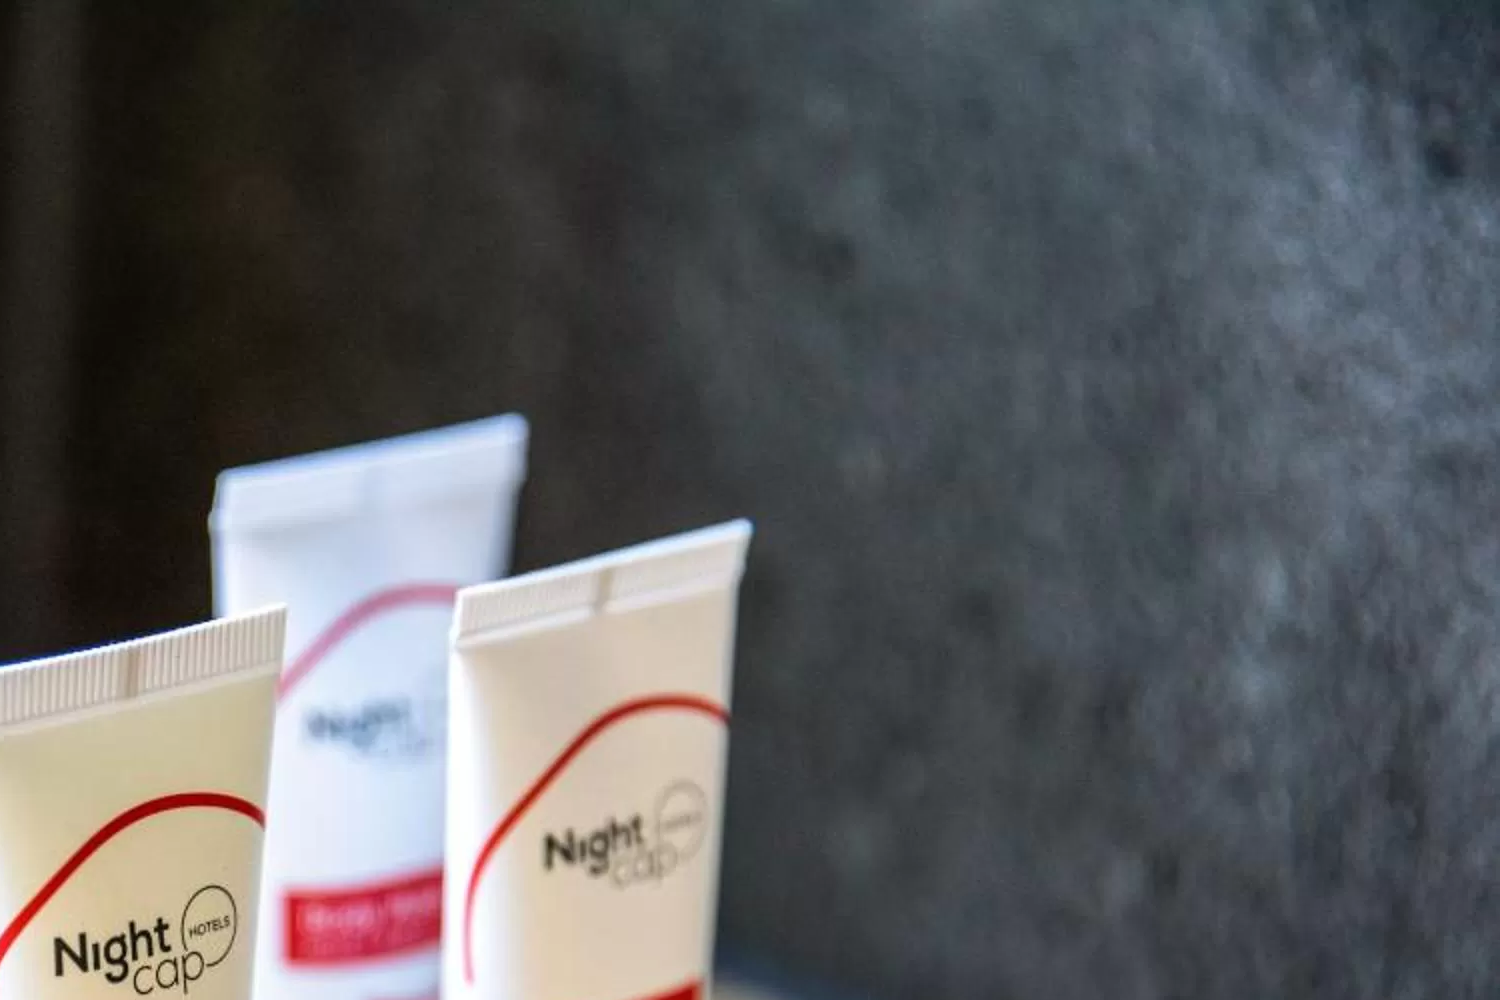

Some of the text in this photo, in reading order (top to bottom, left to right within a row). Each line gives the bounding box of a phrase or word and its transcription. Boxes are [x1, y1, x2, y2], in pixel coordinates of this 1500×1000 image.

[543, 813, 644, 879] Night
[53, 917, 172, 984] Night
[188, 916, 231, 938] HOTELS
[133, 951, 205, 995] cap
